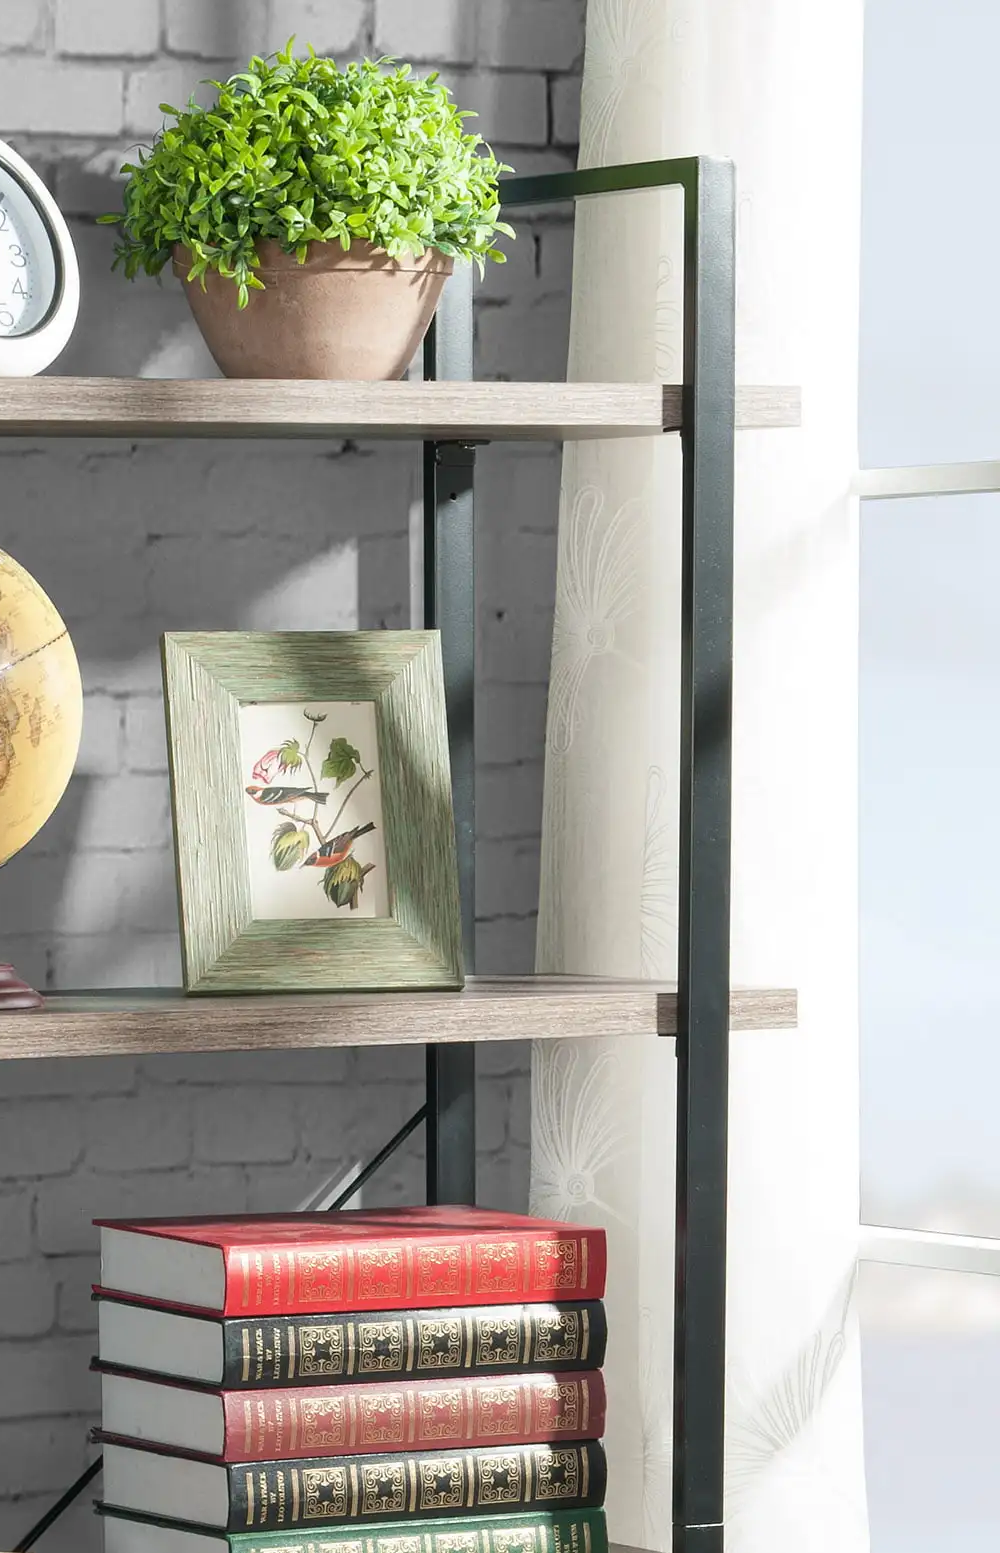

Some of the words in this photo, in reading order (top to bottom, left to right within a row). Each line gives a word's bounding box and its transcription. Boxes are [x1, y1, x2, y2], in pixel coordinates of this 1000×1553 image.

[8, 244, 27, 268] 3
[11, 277, 27, 298] 4
[255, 1328, 263, 1355] PEACE
[273, 1327, 281, 1363] TOLSTOY
[265, 1349, 273, 1361] BY
[255, 1363, 263, 1380] WAR
[273, 1364, 281, 1380] LEO
[259, 1472, 268, 1499] PEACE
[276, 1470, 285, 1506] TOLSTOY
[269, 1492, 277, 1504] BY
[259, 1506, 268, 1524] WAR
[276, 1507, 285, 1522] LEO
[553, 1524, 561, 1540] LEO
[570, 1524, 579, 1541] WAR
